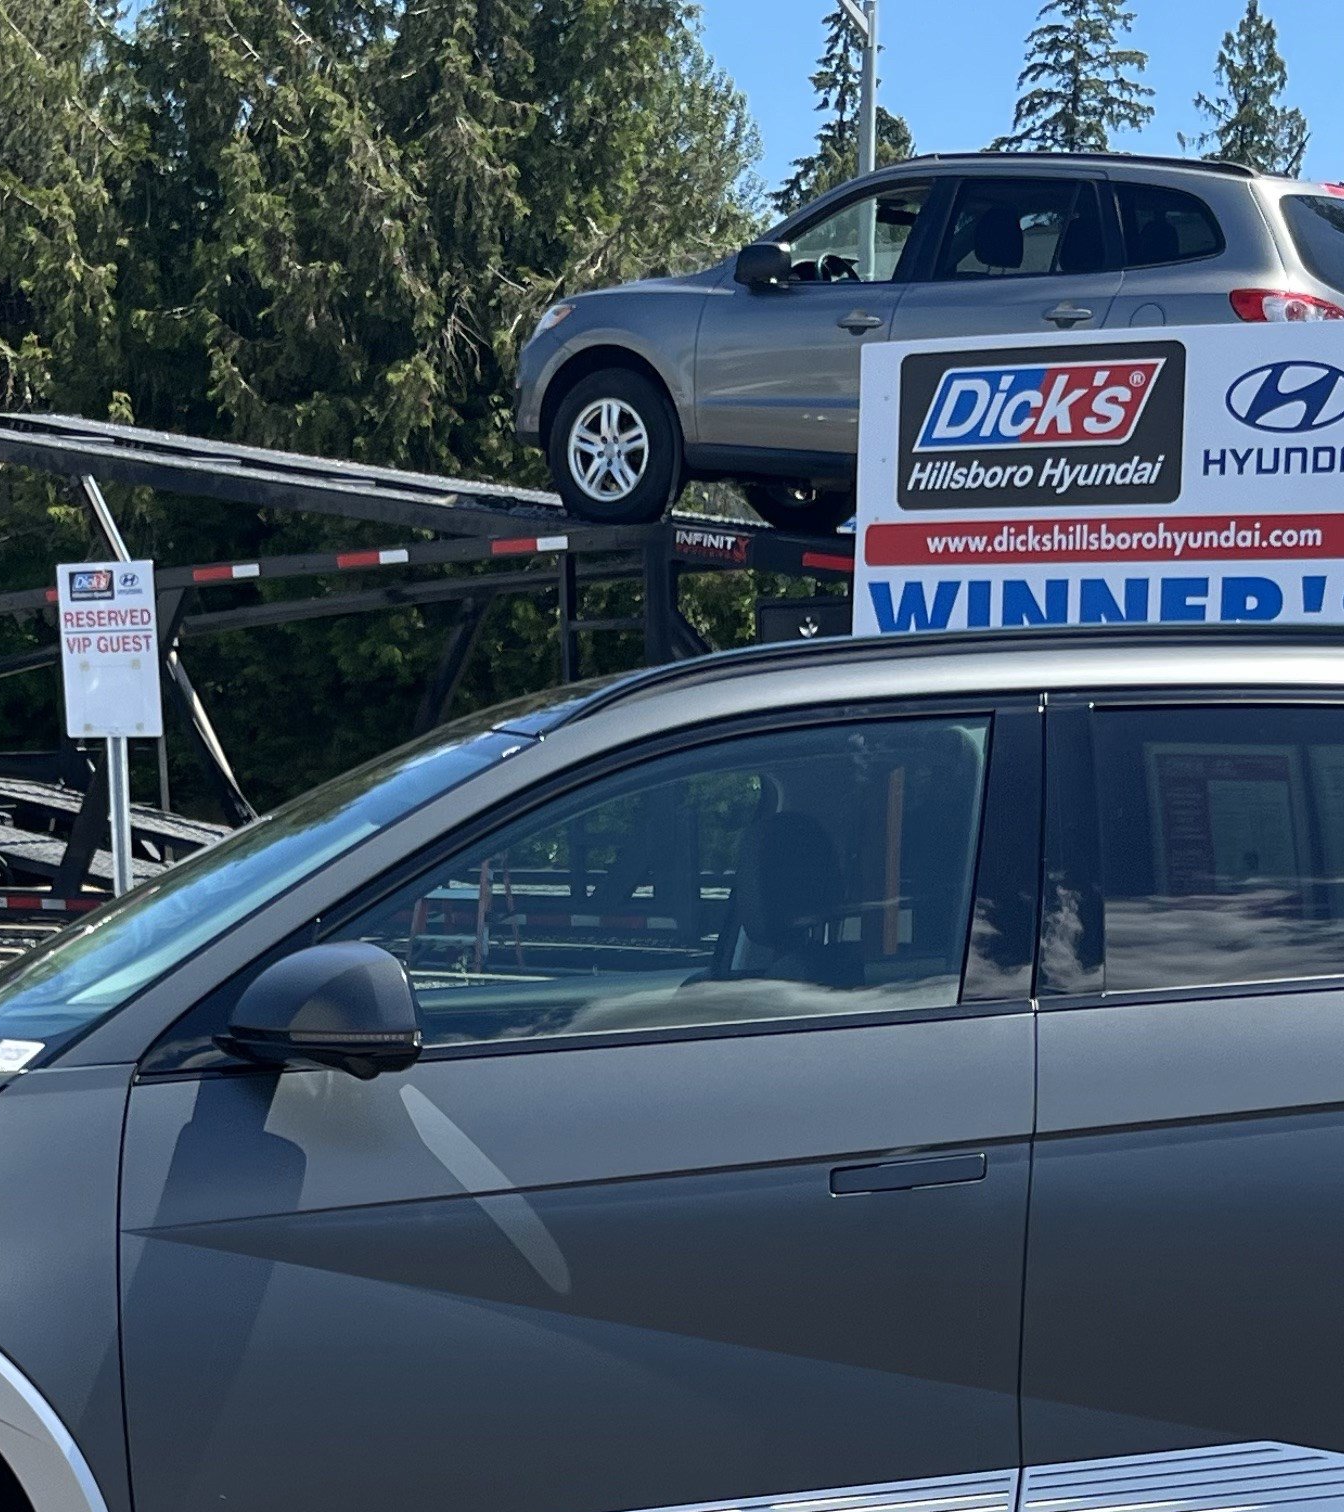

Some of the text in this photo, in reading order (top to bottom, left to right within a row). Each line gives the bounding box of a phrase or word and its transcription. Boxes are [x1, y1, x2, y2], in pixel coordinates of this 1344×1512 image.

[932, 370, 1132, 438] Dick's
[907, 454, 1166, 494] Hillsboro Hyundai
[926, 521, 1323, 556] www.dickshillsborohyundai.com
[64, 608, 151, 629] RESERVED
[66, 634, 152, 655] VIP GUEST
